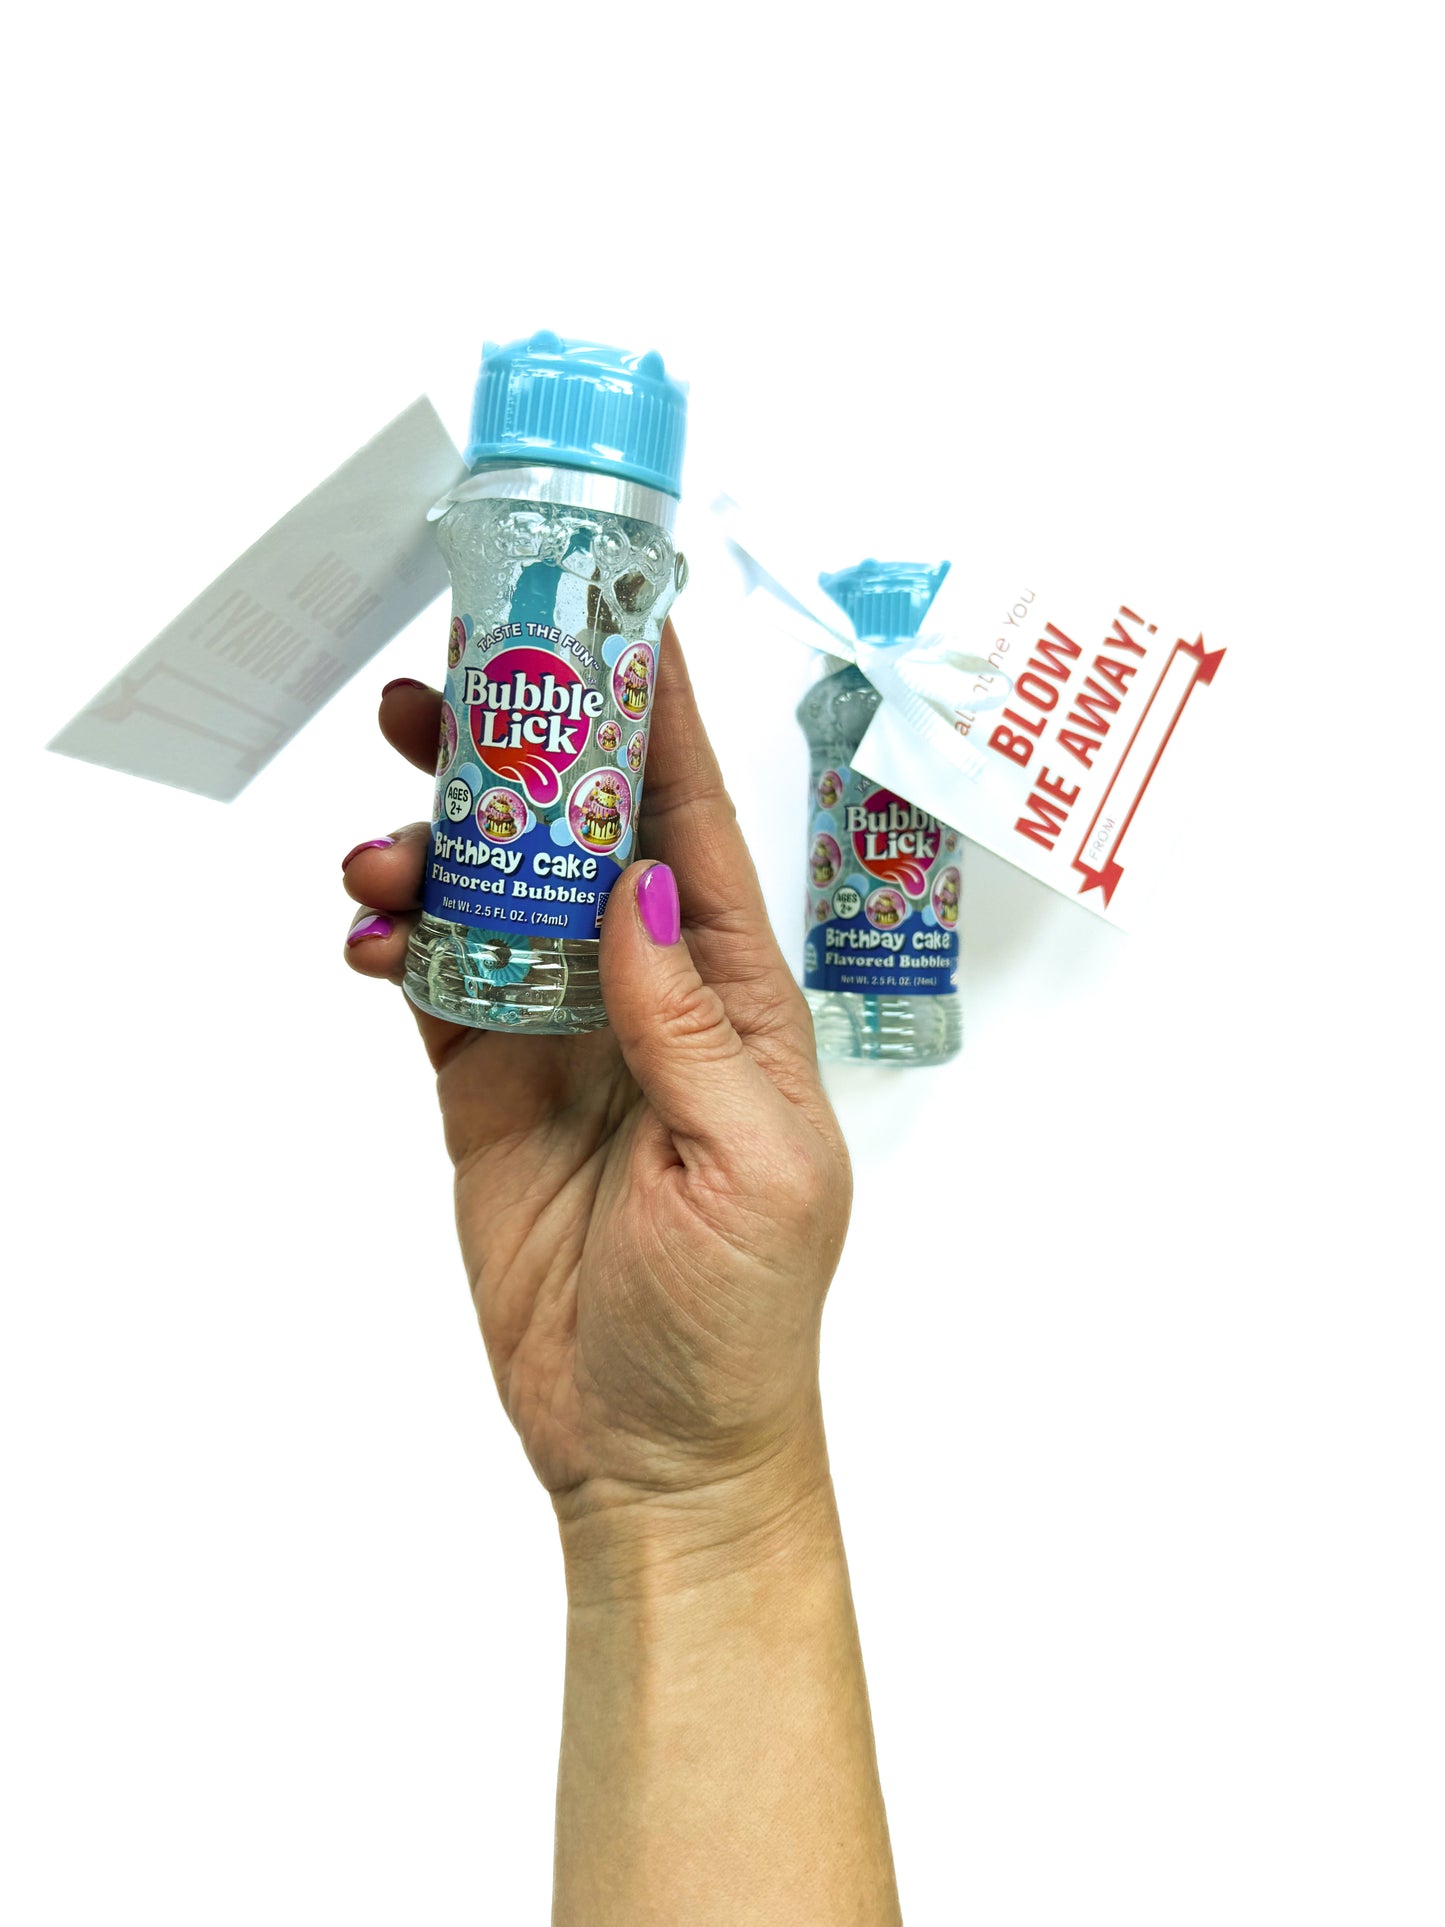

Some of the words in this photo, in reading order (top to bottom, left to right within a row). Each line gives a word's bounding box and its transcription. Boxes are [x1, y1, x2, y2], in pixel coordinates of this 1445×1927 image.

[1002, 587, 1037, 628] You
[477, 622, 522, 652] TASTE
[526, 622, 561, 642] THE
[463, 667, 604, 721] Bubble
[987, 621, 1083, 768] BLOW
[478, 710, 578, 754] Lick
[1013, 765, 1081, 852] ME
[1056, 604, 1159, 770] AWAY!
[447, 785, 469, 802] AGES
[450, 801, 463, 815] 2+
[863, 831, 936, 861] Lick
[431, 864, 505, 895] Flavored
[511, 880, 596, 904] Bubbles
[836, 893, 858, 904] AGES
[442, 896, 456, 909] Net
[457, 899, 472, 913] Wt.
[475, 904, 491, 917] 2.5
[493, 907, 507, 919] FL
[509, 910, 528, 922] OZ.
[531, 911, 569, 927] (74mL)
[825, 952, 895, 967] Flavored
[899, 953, 951, 968] Bubbles
[841, 974, 854, 984] Net
[871, 975, 885, 985] 2.5
[899, 976, 912, 986] OZ.
